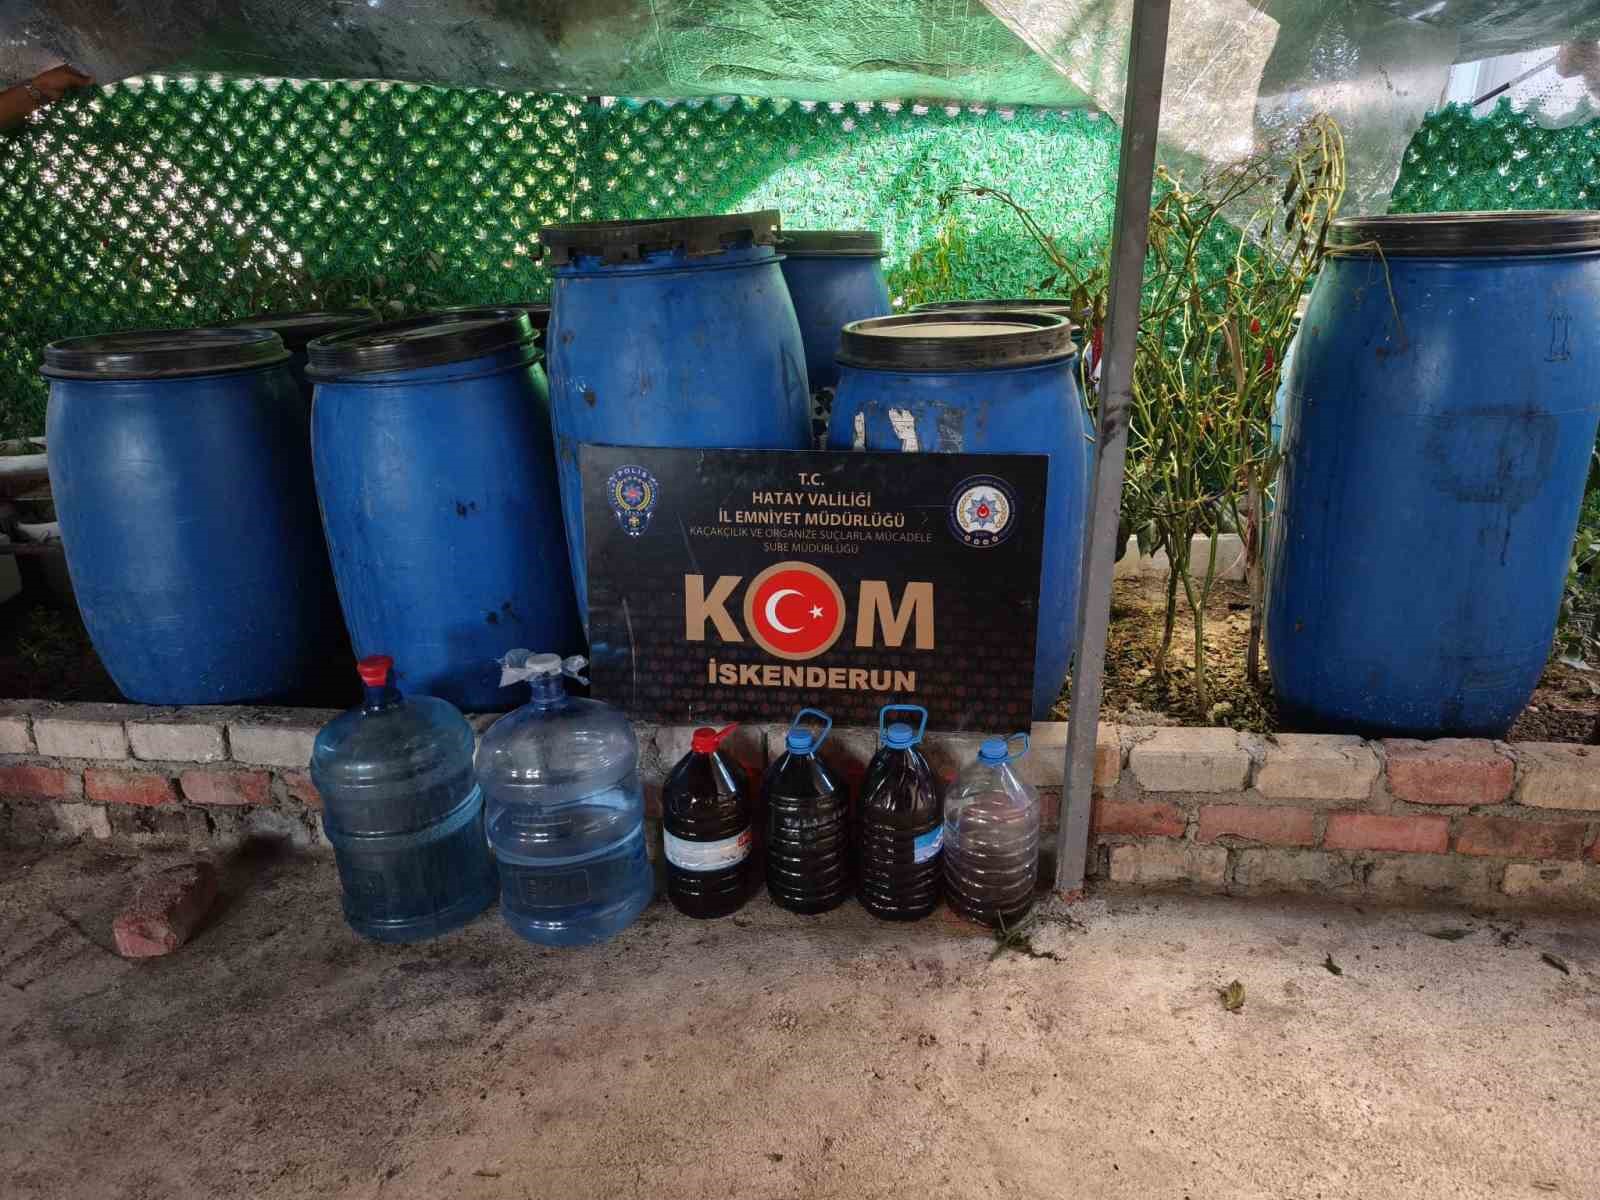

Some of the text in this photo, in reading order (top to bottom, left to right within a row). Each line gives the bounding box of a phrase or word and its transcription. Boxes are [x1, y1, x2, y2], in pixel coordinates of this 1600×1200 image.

[798, 472, 826, 487] T.C.
[752, 490, 872, 508] HATAY VALİLİĞİ
[718, 507, 906, 528] İL EMNİYET MÜDÜRLÜĞÜ
[751, 527, 763, 537] VE
[685, 560, 935, 661] KOM
[708, 657, 916, 693] İSKENDERUN
